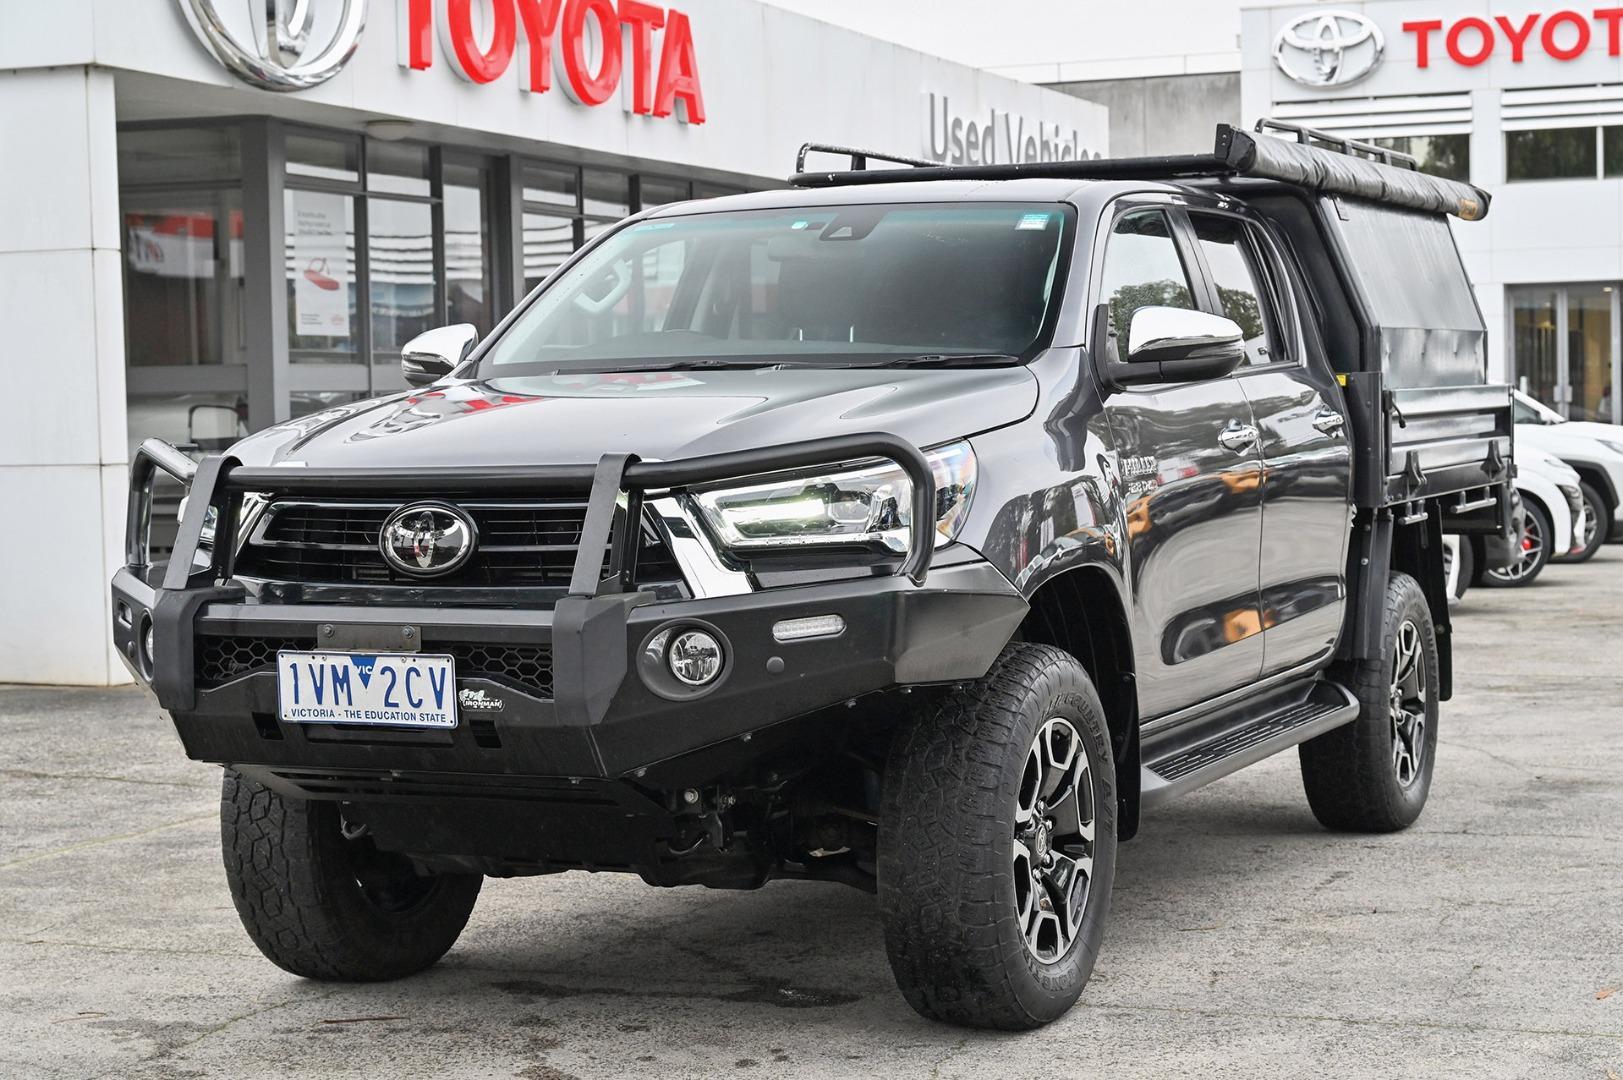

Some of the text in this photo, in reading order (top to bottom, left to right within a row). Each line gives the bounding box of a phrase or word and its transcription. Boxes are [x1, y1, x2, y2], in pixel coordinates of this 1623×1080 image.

[930, 92, 995, 165] Used
[290, 662, 447, 710] 1VM 2CV
[291, 708, 335, 718] VICTORIA
[344, 709, 362, 719] THE
[365, 710, 416, 721] EDUCATION
[420, 712, 447, 722] STATE
